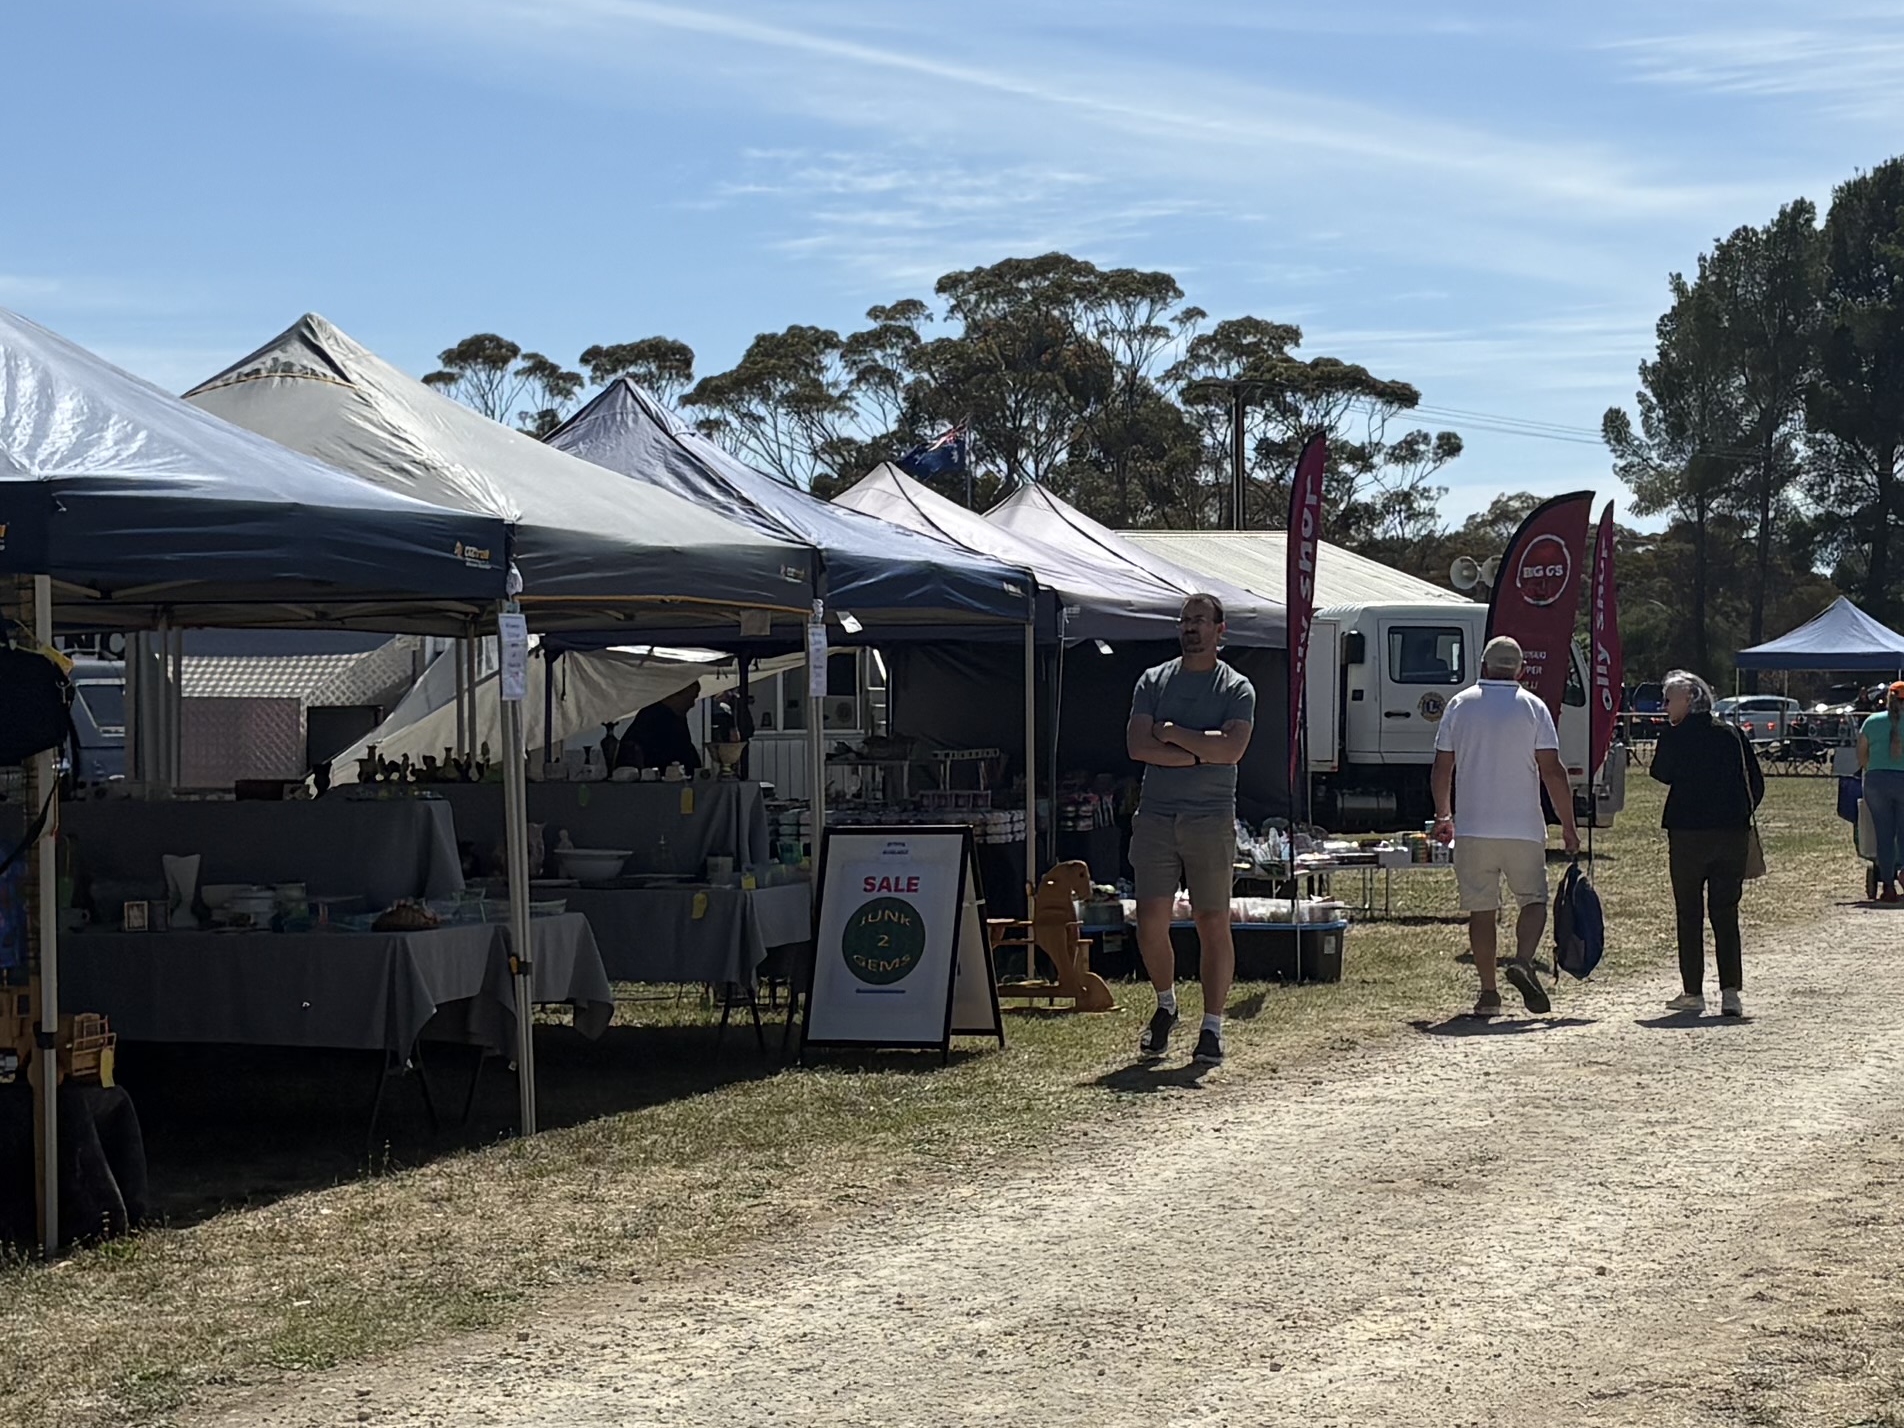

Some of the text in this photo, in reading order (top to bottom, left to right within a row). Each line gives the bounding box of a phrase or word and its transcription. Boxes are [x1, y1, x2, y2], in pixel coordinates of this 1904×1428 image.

[863, 876, 920, 893] SALE
[859, 909, 911, 927] JUNK
[877, 934, 890, 947] 2
[853, 954, 911, 972] GEMS
